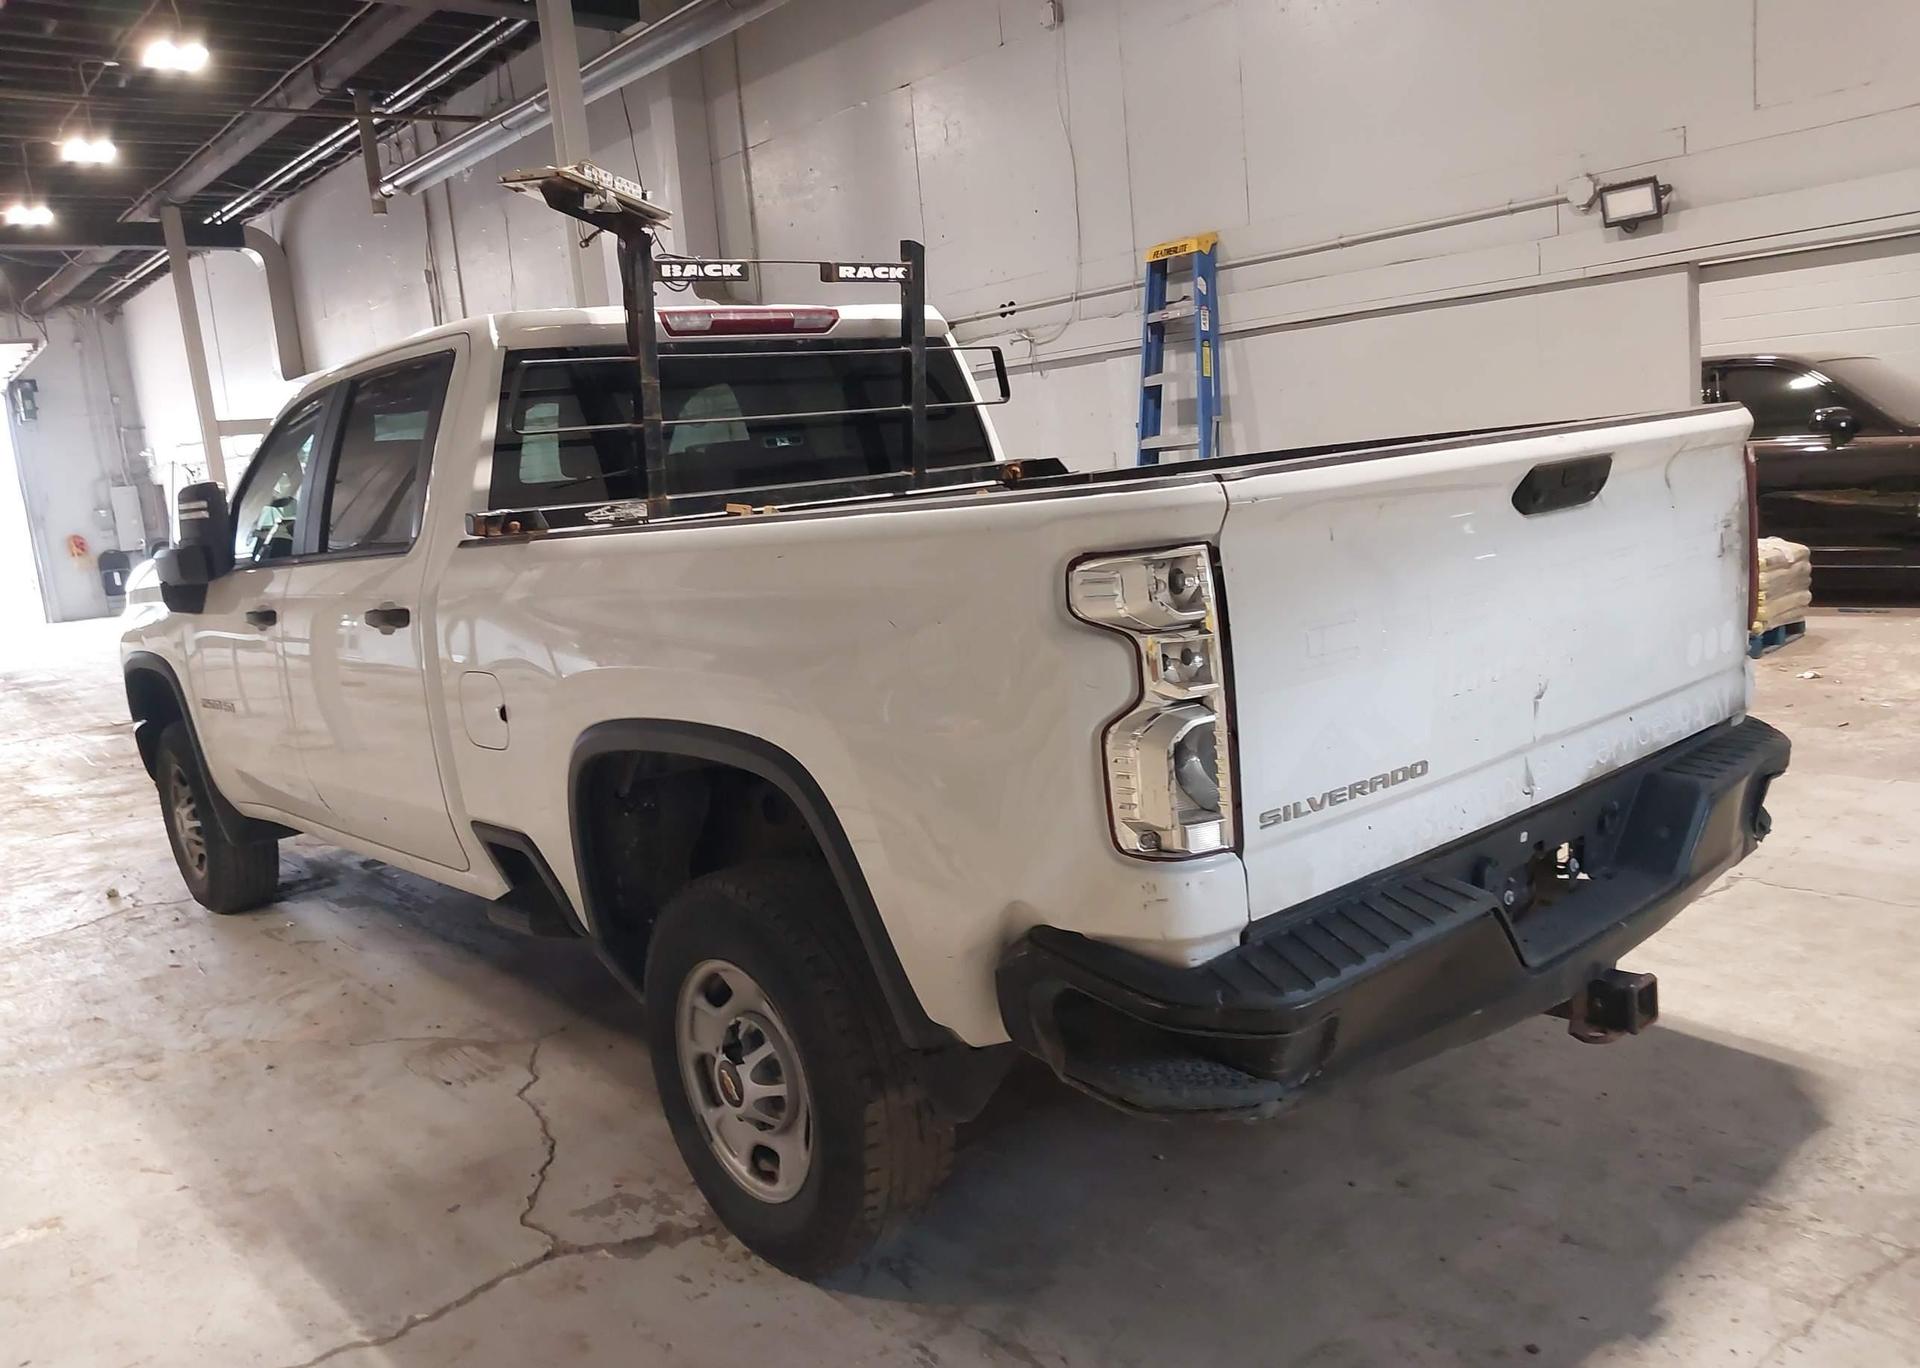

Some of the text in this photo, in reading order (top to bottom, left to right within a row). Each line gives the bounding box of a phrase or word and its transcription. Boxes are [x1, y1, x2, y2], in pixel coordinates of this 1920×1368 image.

[661, 264, 906, 279] BACK RACK
[1258, 759, 1429, 830] SILVERADO
